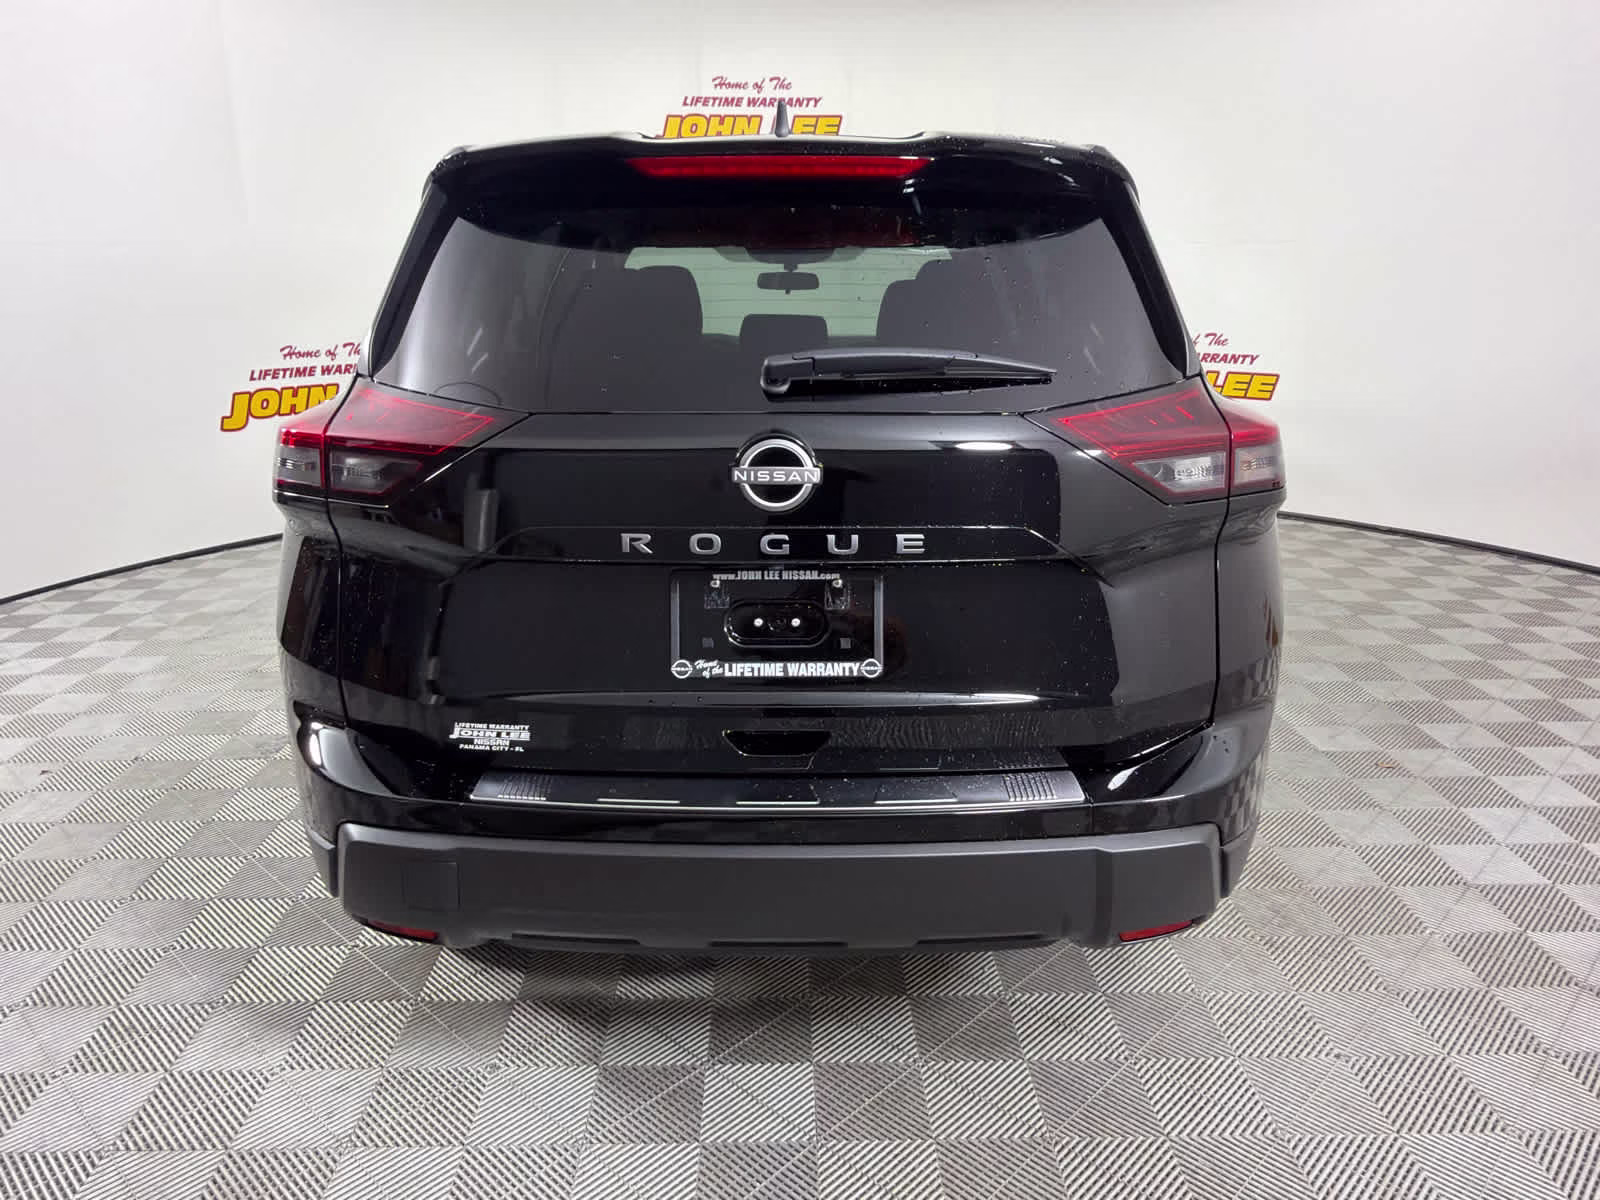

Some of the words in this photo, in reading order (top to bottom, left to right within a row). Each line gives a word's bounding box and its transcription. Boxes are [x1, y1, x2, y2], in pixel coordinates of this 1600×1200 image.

[711, 76, 749, 90] Home
[752, 77, 766, 93] of
[769, 76, 793, 90] The
[682, 96, 744, 107] LIFETIME
[655, 113, 763, 138] JOHN
[771, 114, 843, 136] EE
[1204, 332, 1230, 347] The
[280, 344, 321, 360] Home
[325, 344, 338, 361] of
[343, 342, 361, 357] Th
[249, 365, 317, 382] LIFETIME
[220, 383, 339, 432] JOHN
[733, 470, 819, 482] NISSAN
[620, 532, 925, 555] ROGUE
[764, 570, 780, 580] LEE
[724, 663, 784, 677] LIFETIME
[787, 662, 860, 676] WARRANTY
[449, 727, 497, 739] JOHN
[501, 731, 531, 741] LEE
[474, 738, 510, 746] NISSAN
